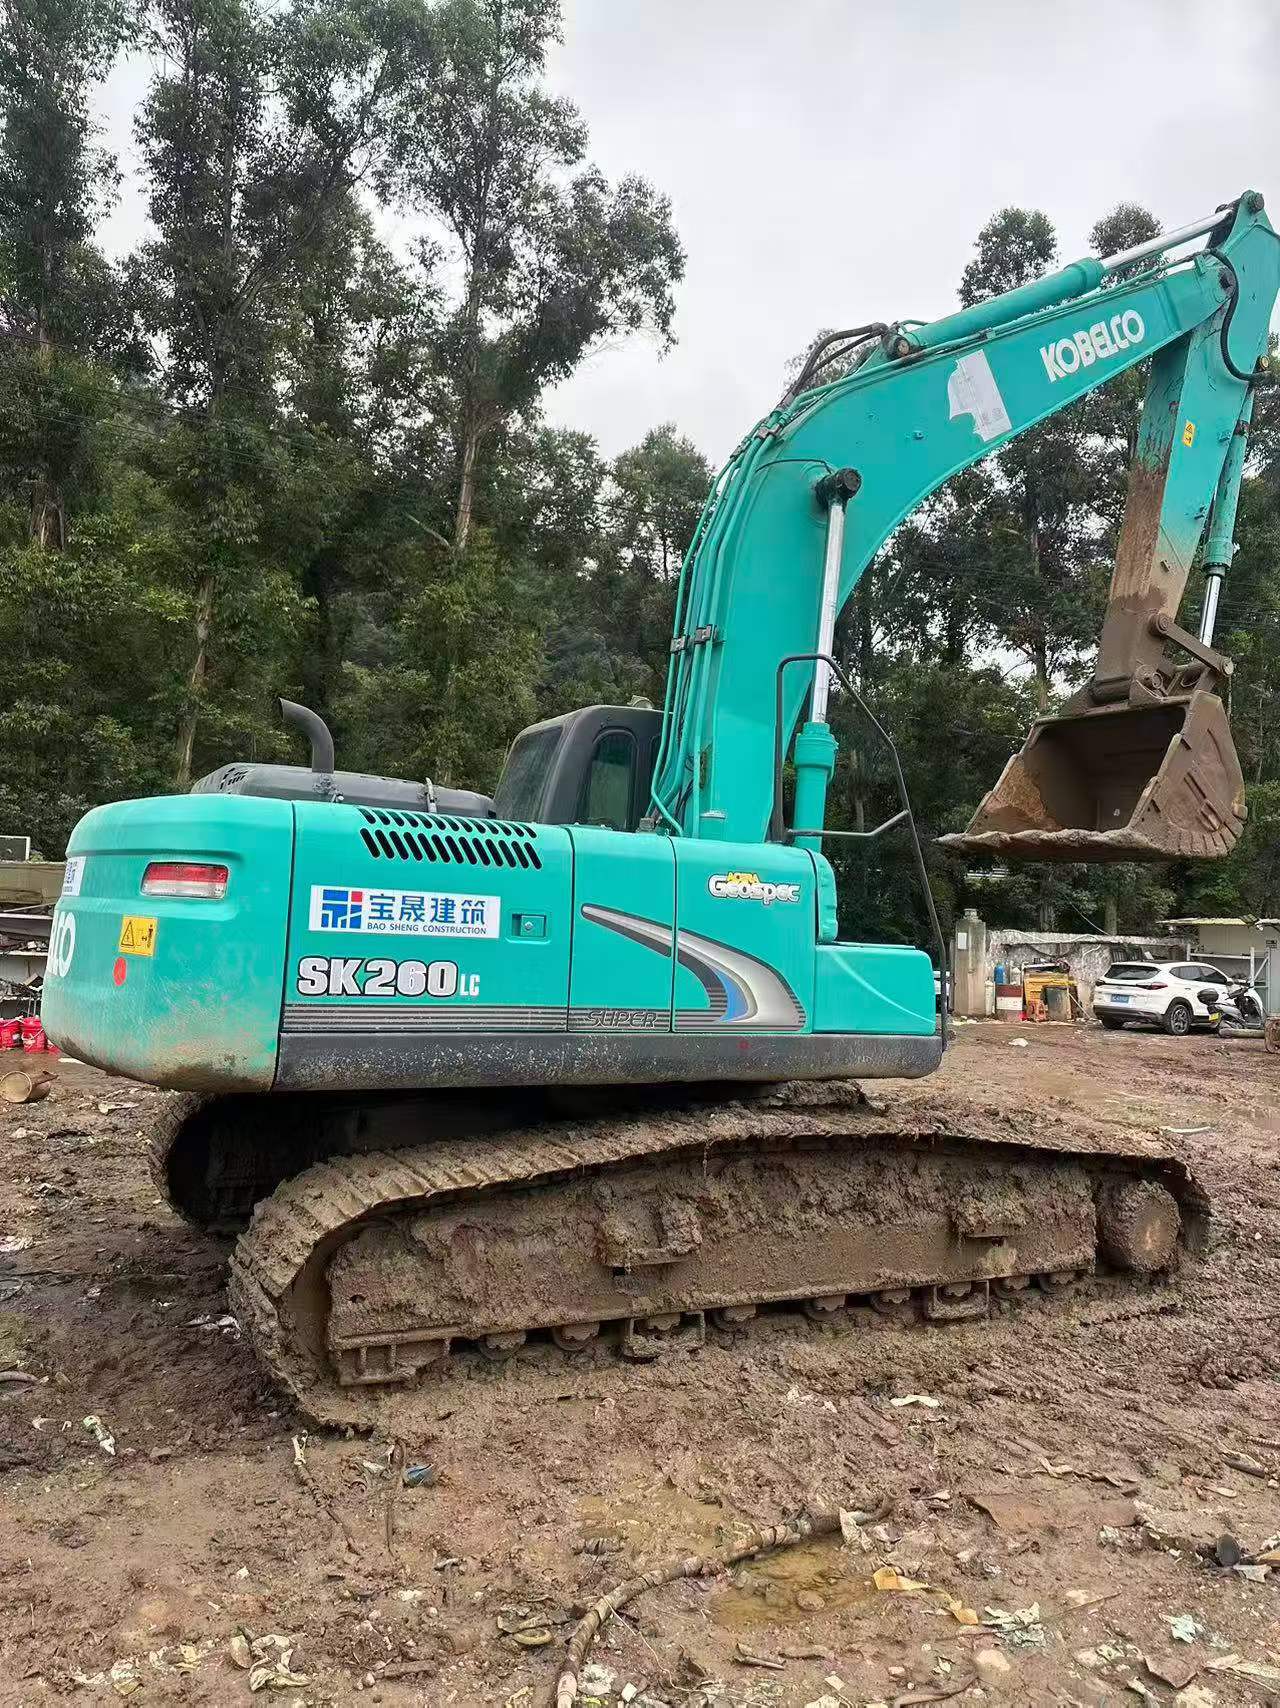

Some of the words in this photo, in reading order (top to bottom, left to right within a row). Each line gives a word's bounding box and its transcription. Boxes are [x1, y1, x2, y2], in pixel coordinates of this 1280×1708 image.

[1039, 309, 1146, 383] KOBELCO
[708, 874, 801, 905] Geospec
[368, 893, 486, 926] 宝晟建筑
[367, 922, 387, 931] BAO
[389, 924, 419, 932] SHENG
[422, 925, 487, 935] CONSTRUCTION
[297, 955, 459, 998] SK260
[459, 974, 481, 996] LC
[587, 1010, 657, 1029] SUPER
